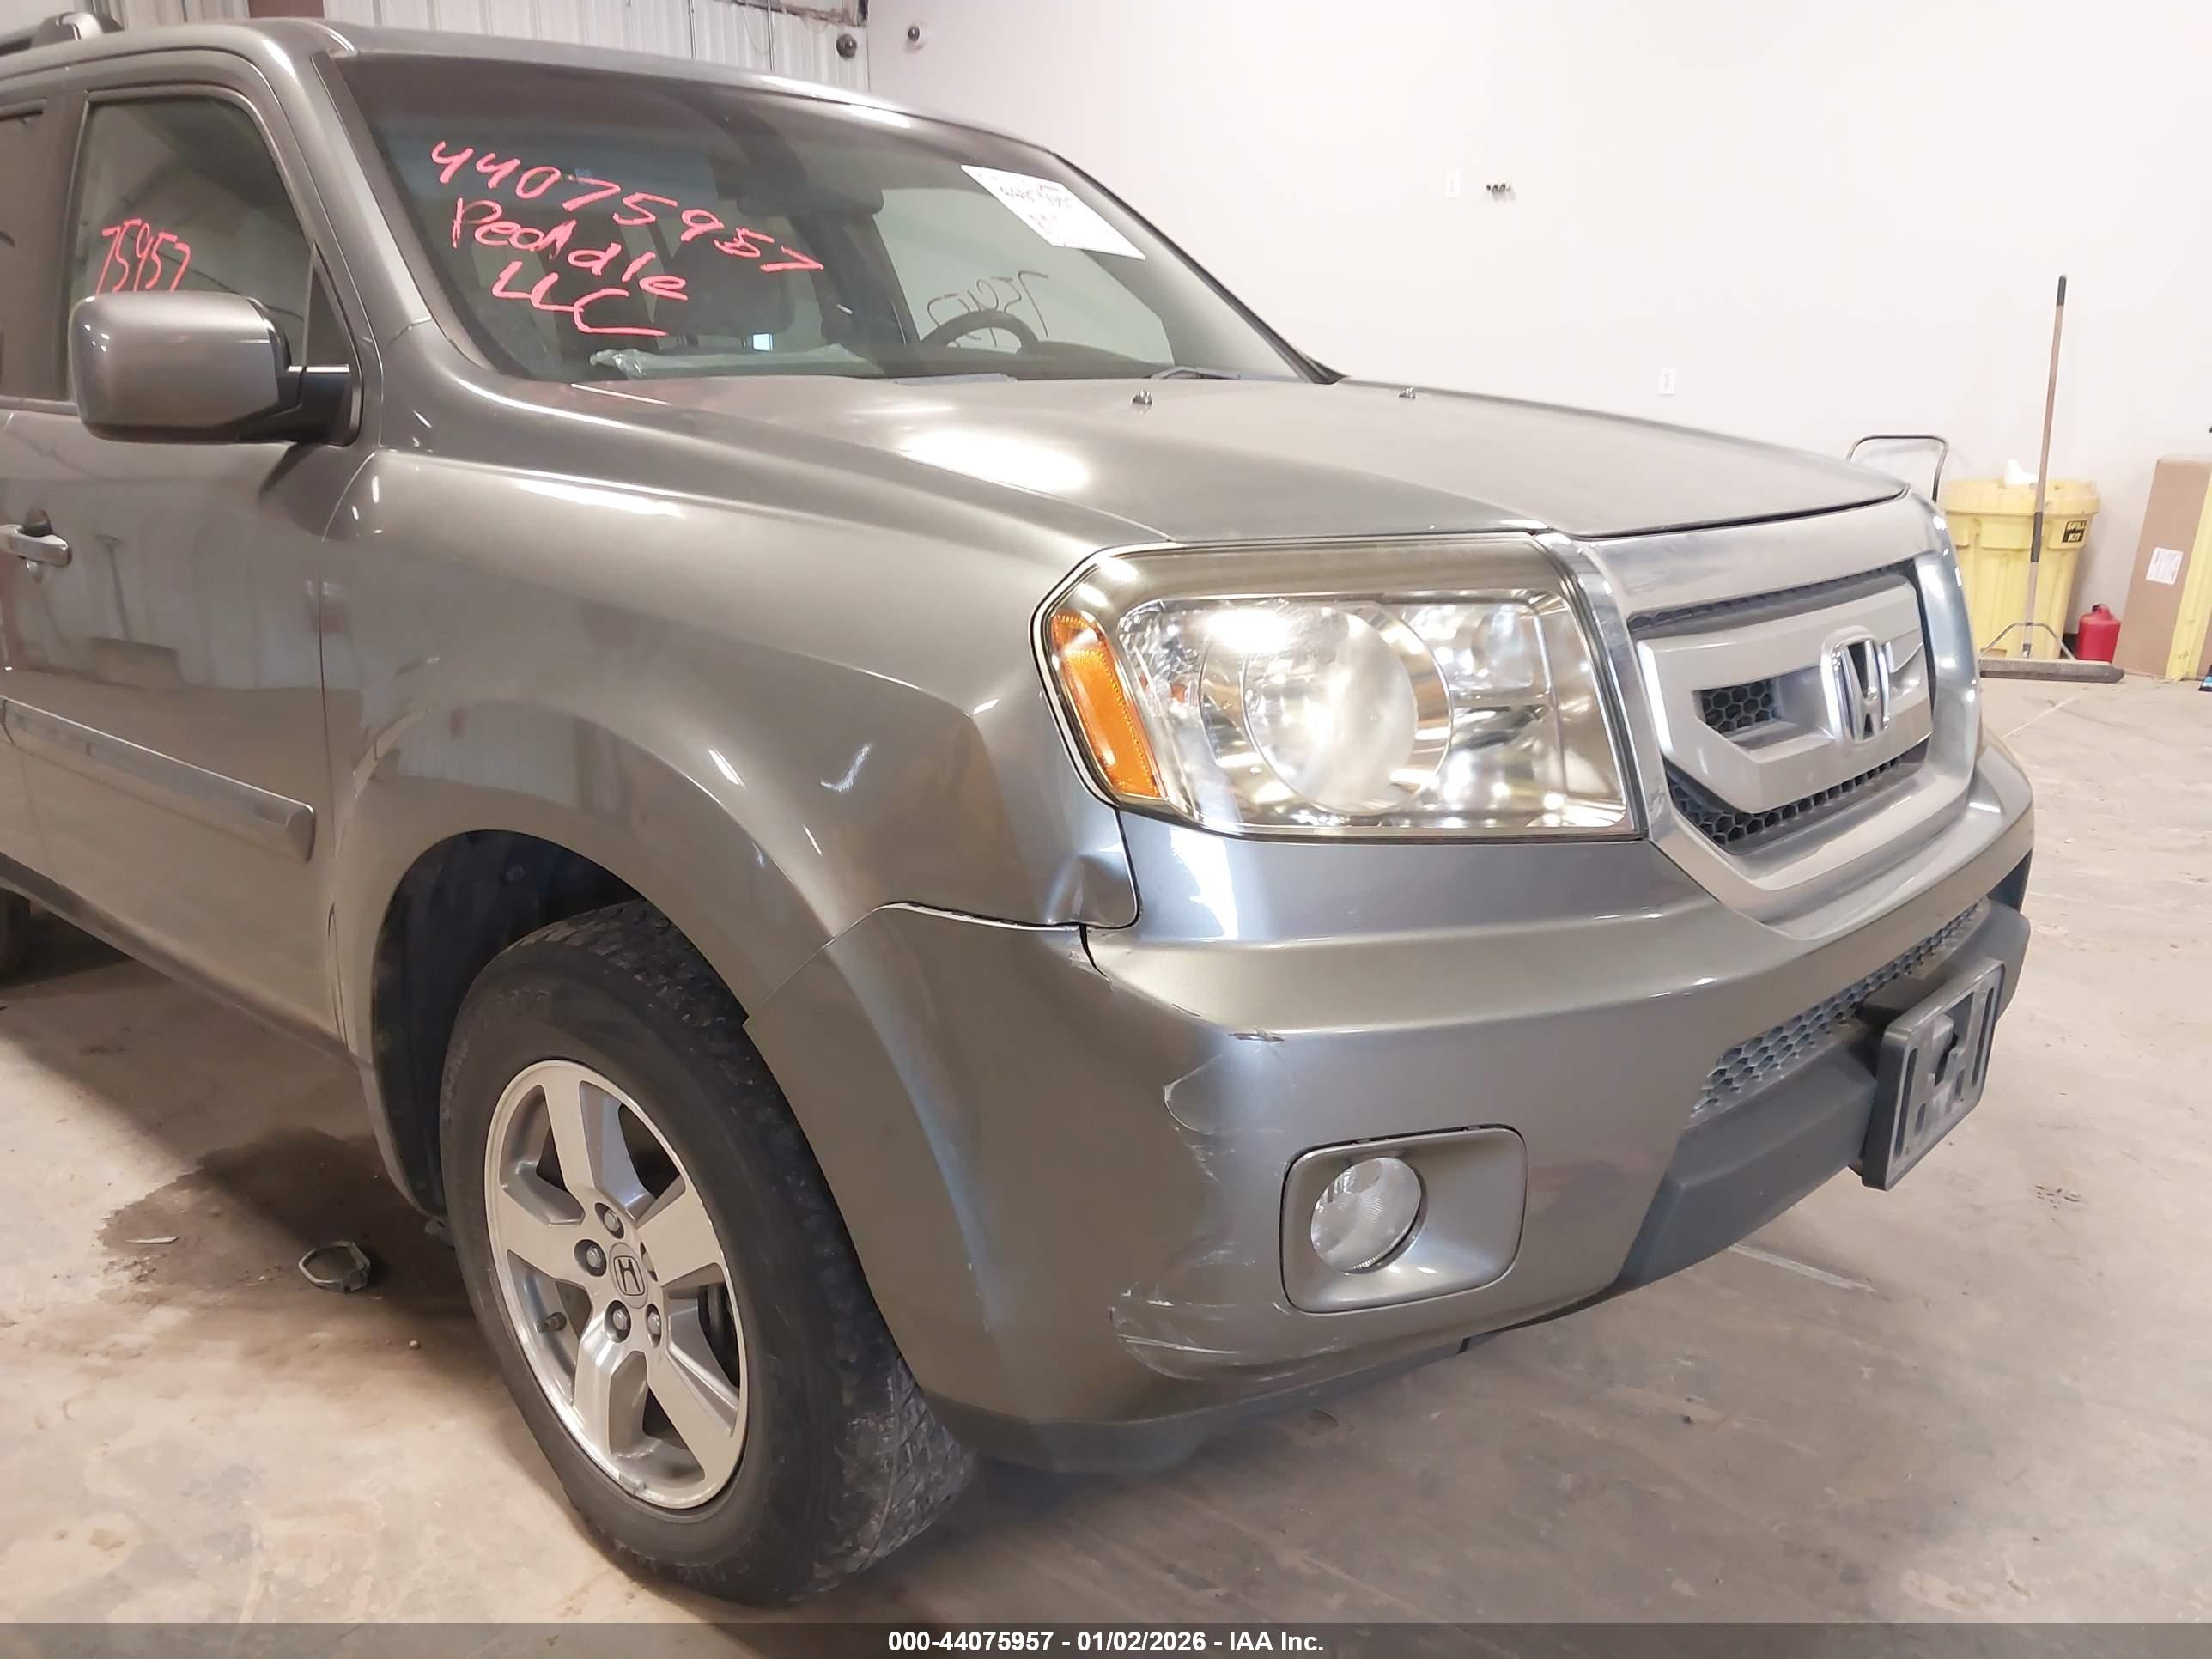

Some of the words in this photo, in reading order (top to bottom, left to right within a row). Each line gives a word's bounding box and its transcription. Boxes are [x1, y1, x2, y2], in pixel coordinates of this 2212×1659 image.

[431, 141, 824, 272] 44075957
[95, 218, 191, 295] 75957
[491, 260, 667, 337] LLC
[2067, 532, 2082, 542] KIT
